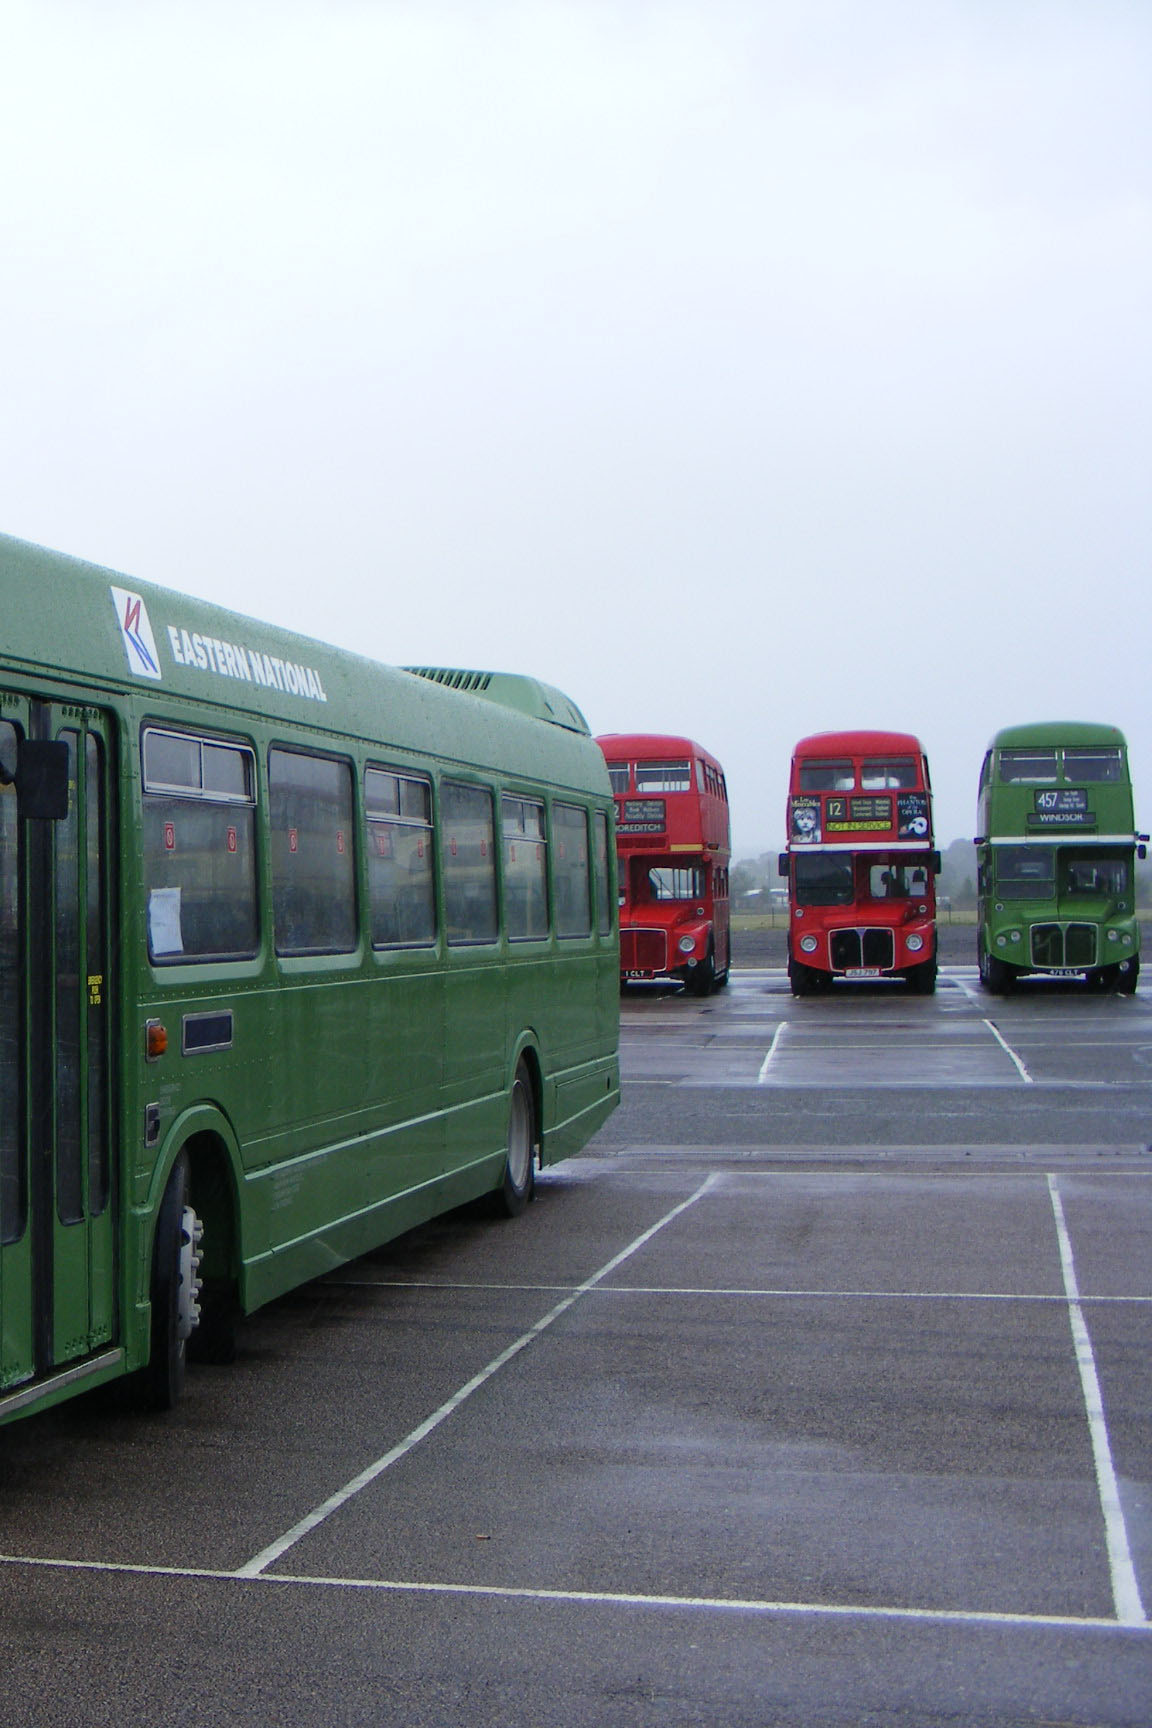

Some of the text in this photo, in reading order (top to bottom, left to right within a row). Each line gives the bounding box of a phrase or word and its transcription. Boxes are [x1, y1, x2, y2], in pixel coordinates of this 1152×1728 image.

[167, 624, 328, 702] EASTERN NATIONAL
[1038, 792, 1058, 808] 457
[829, 802, 842, 816] 12
[1039, 813, 1083, 822] WINDSOR
[616, 823, 661, 832] OREDITCH
